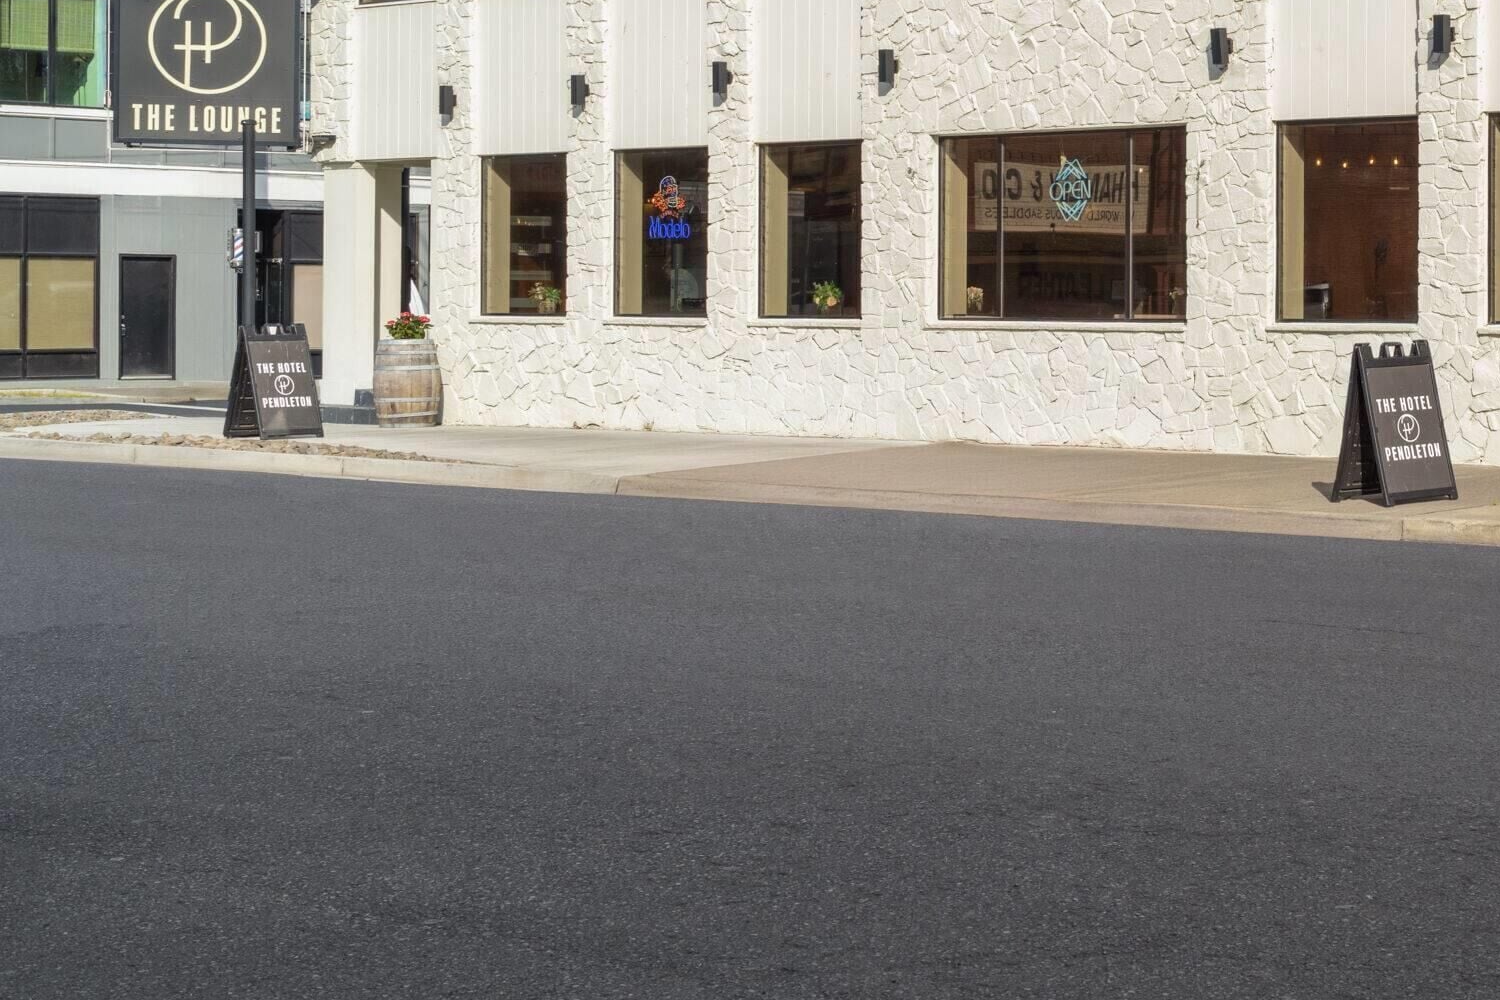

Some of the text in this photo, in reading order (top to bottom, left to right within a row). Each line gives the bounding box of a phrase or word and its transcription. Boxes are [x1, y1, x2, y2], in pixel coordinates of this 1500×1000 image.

[131, 103, 282, 134] THE LOUNGE
[1049, 179, 1092, 201] OPEN
[649, 216, 690, 239] Modelo
[256, 361, 307, 374] THE HOTEL
[261, 395, 313, 409] PENDLETON
[1375, 395, 1433, 413] THE HOTEL
[1384, 442, 1442, 462] PENDLETON
